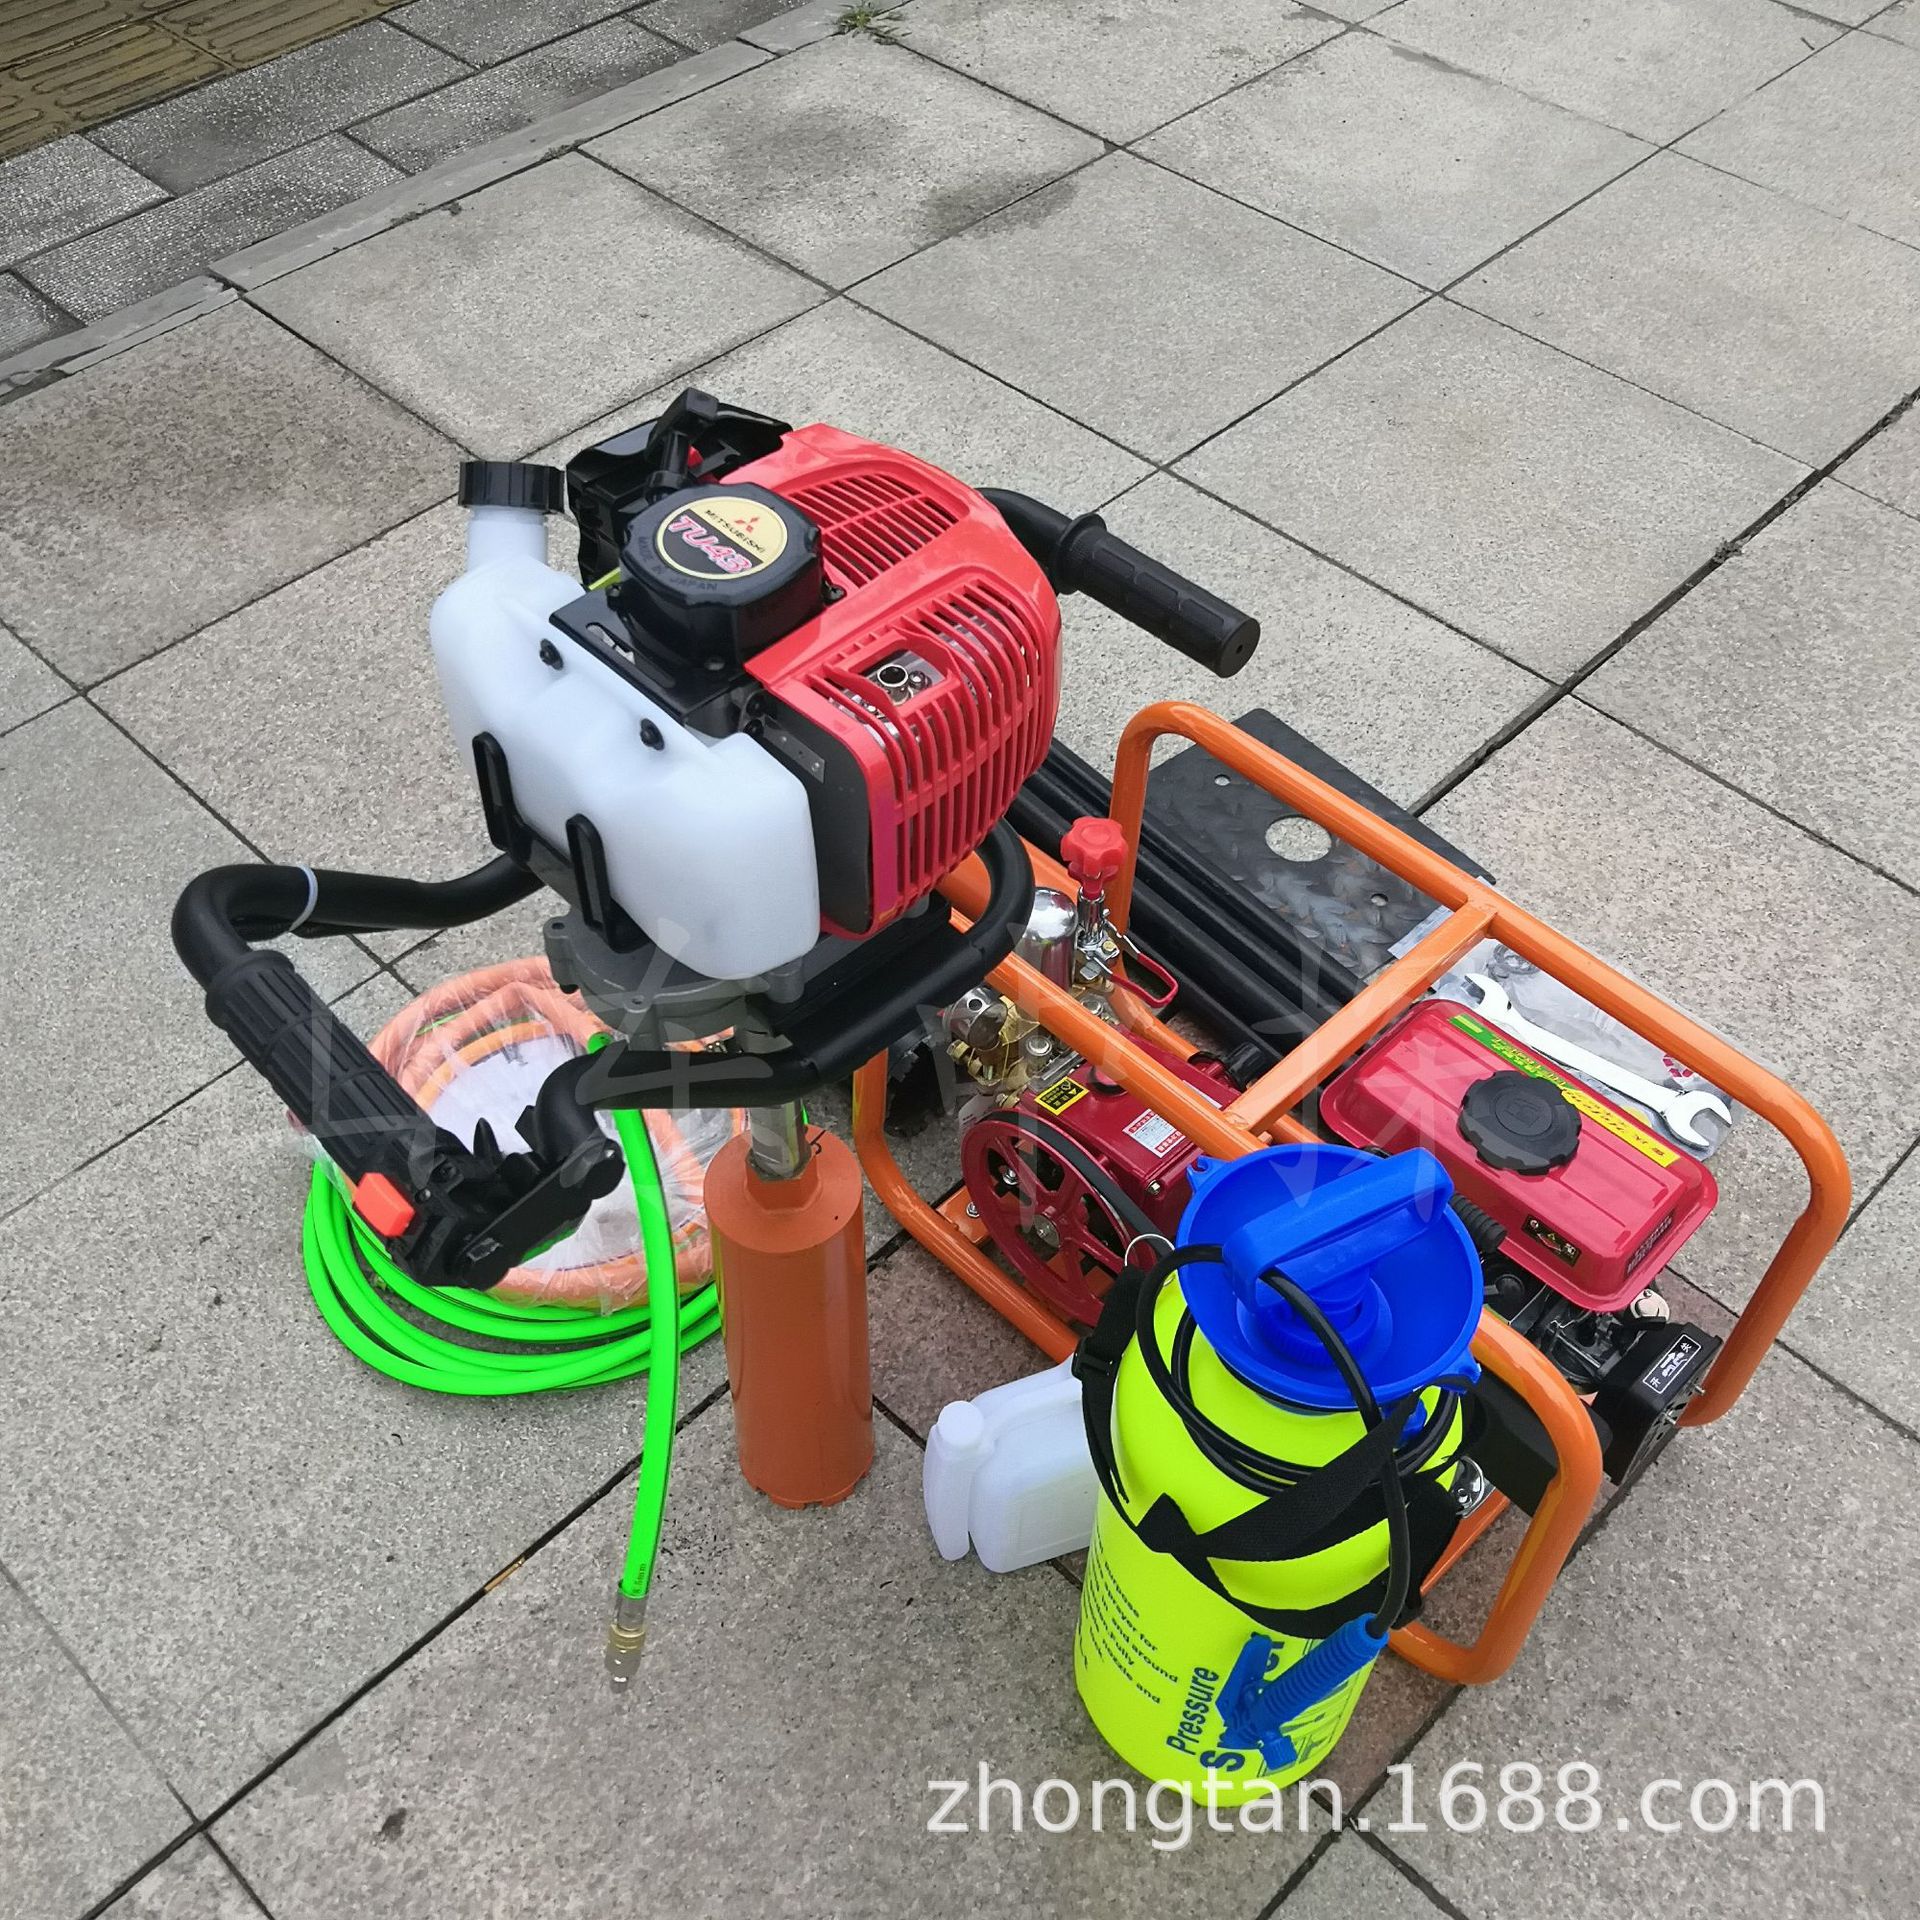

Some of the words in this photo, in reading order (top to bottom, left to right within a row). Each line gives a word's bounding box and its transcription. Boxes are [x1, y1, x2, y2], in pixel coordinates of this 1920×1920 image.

[668, 514, 753, 574] TU43
[705, 509, 766, 554] MITSUBISHI
[669, 577, 718, 592] JAPAN
[1650, 1377, 1661, 1388] 开
[1139, 1633, 1158, 1652] for
[1132, 1643, 1179, 1683] around
[1136, 1682, 1161, 1704] and
[1166, 1666, 1220, 1756] Pressure
